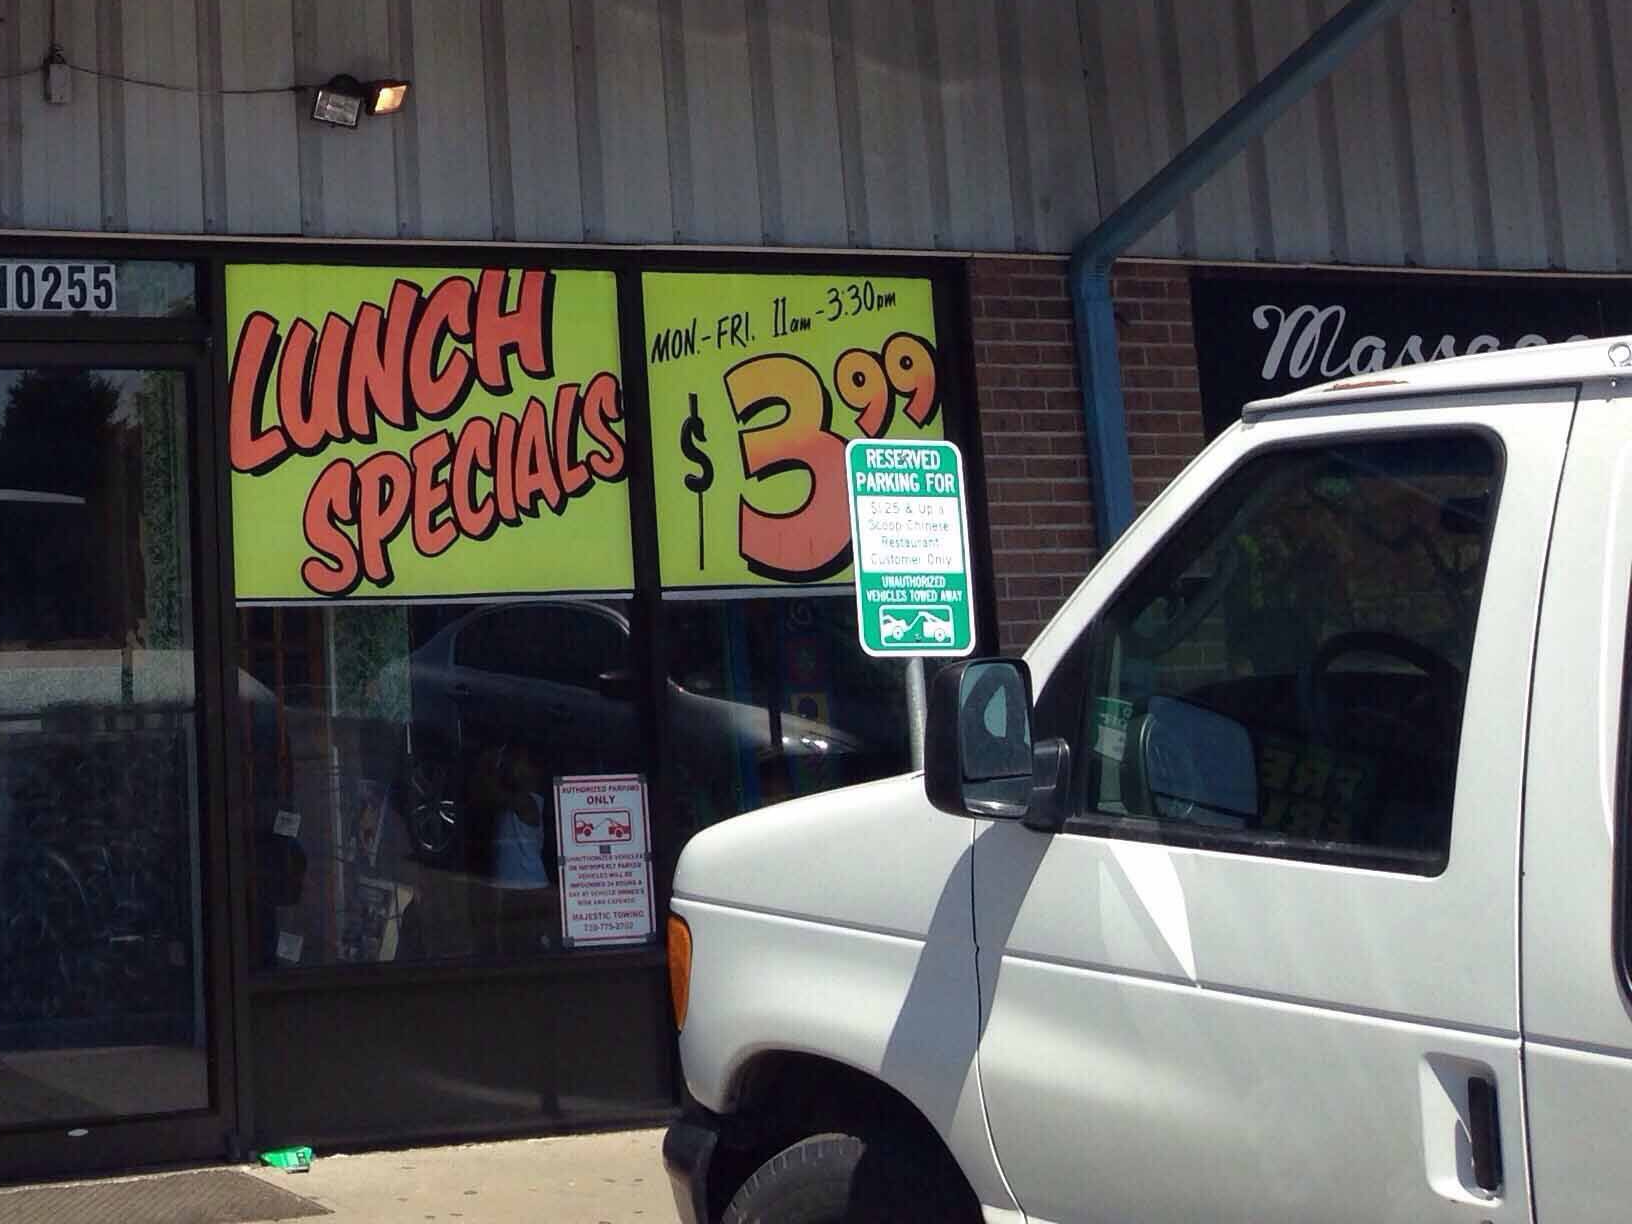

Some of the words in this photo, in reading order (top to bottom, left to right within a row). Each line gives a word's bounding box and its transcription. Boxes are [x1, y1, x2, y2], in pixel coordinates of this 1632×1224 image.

[1253, 304, 1589, 379] Mass
[230, 268, 555, 473] LUNCH
[865, 449, 941, 470] RESERVED
[301, 372, 628, 595] SPECIALS
[856, 472, 920, 492] PARKING
[925, 473, 955, 493] FOR
[928, 553, 952, 566] Only
[882, 575, 946, 588] UNAUTHORIZED
[866, 590, 907, 602] VEHICLES
[909, 590, 938, 601] TOWED
[941, 590, 963, 601] AWAY
[586, 795, 616, 805] ONLY
